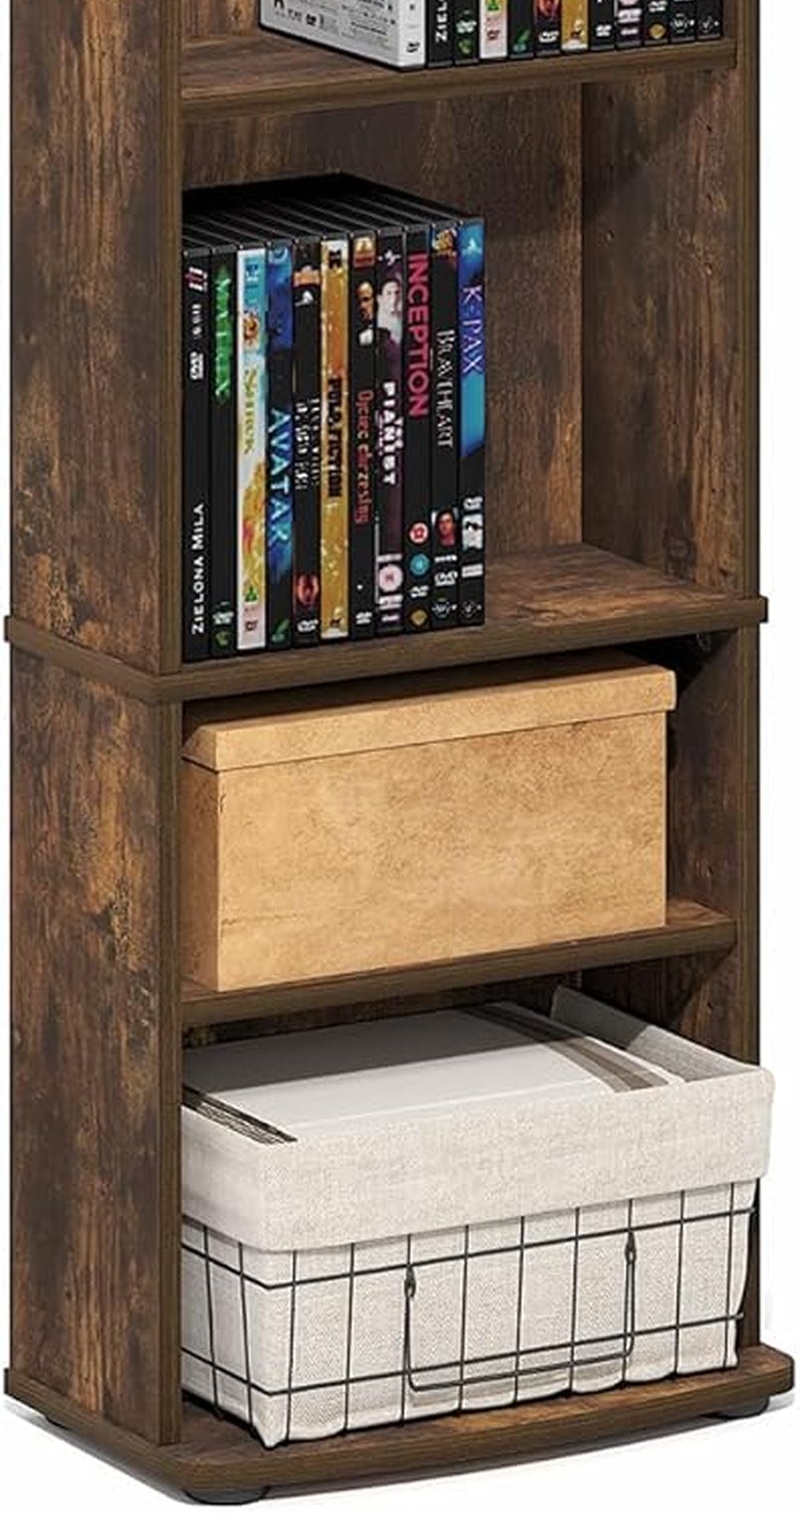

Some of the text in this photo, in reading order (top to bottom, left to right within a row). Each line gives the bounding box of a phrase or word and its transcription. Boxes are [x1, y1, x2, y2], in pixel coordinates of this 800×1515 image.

[408, 252, 430, 417] INCEPTION
[462, 285, 483, 374] K-PAX
[268, 409, 291, 546] AVATAR
[191, 503, 205, 635] ZIELONA MILA
